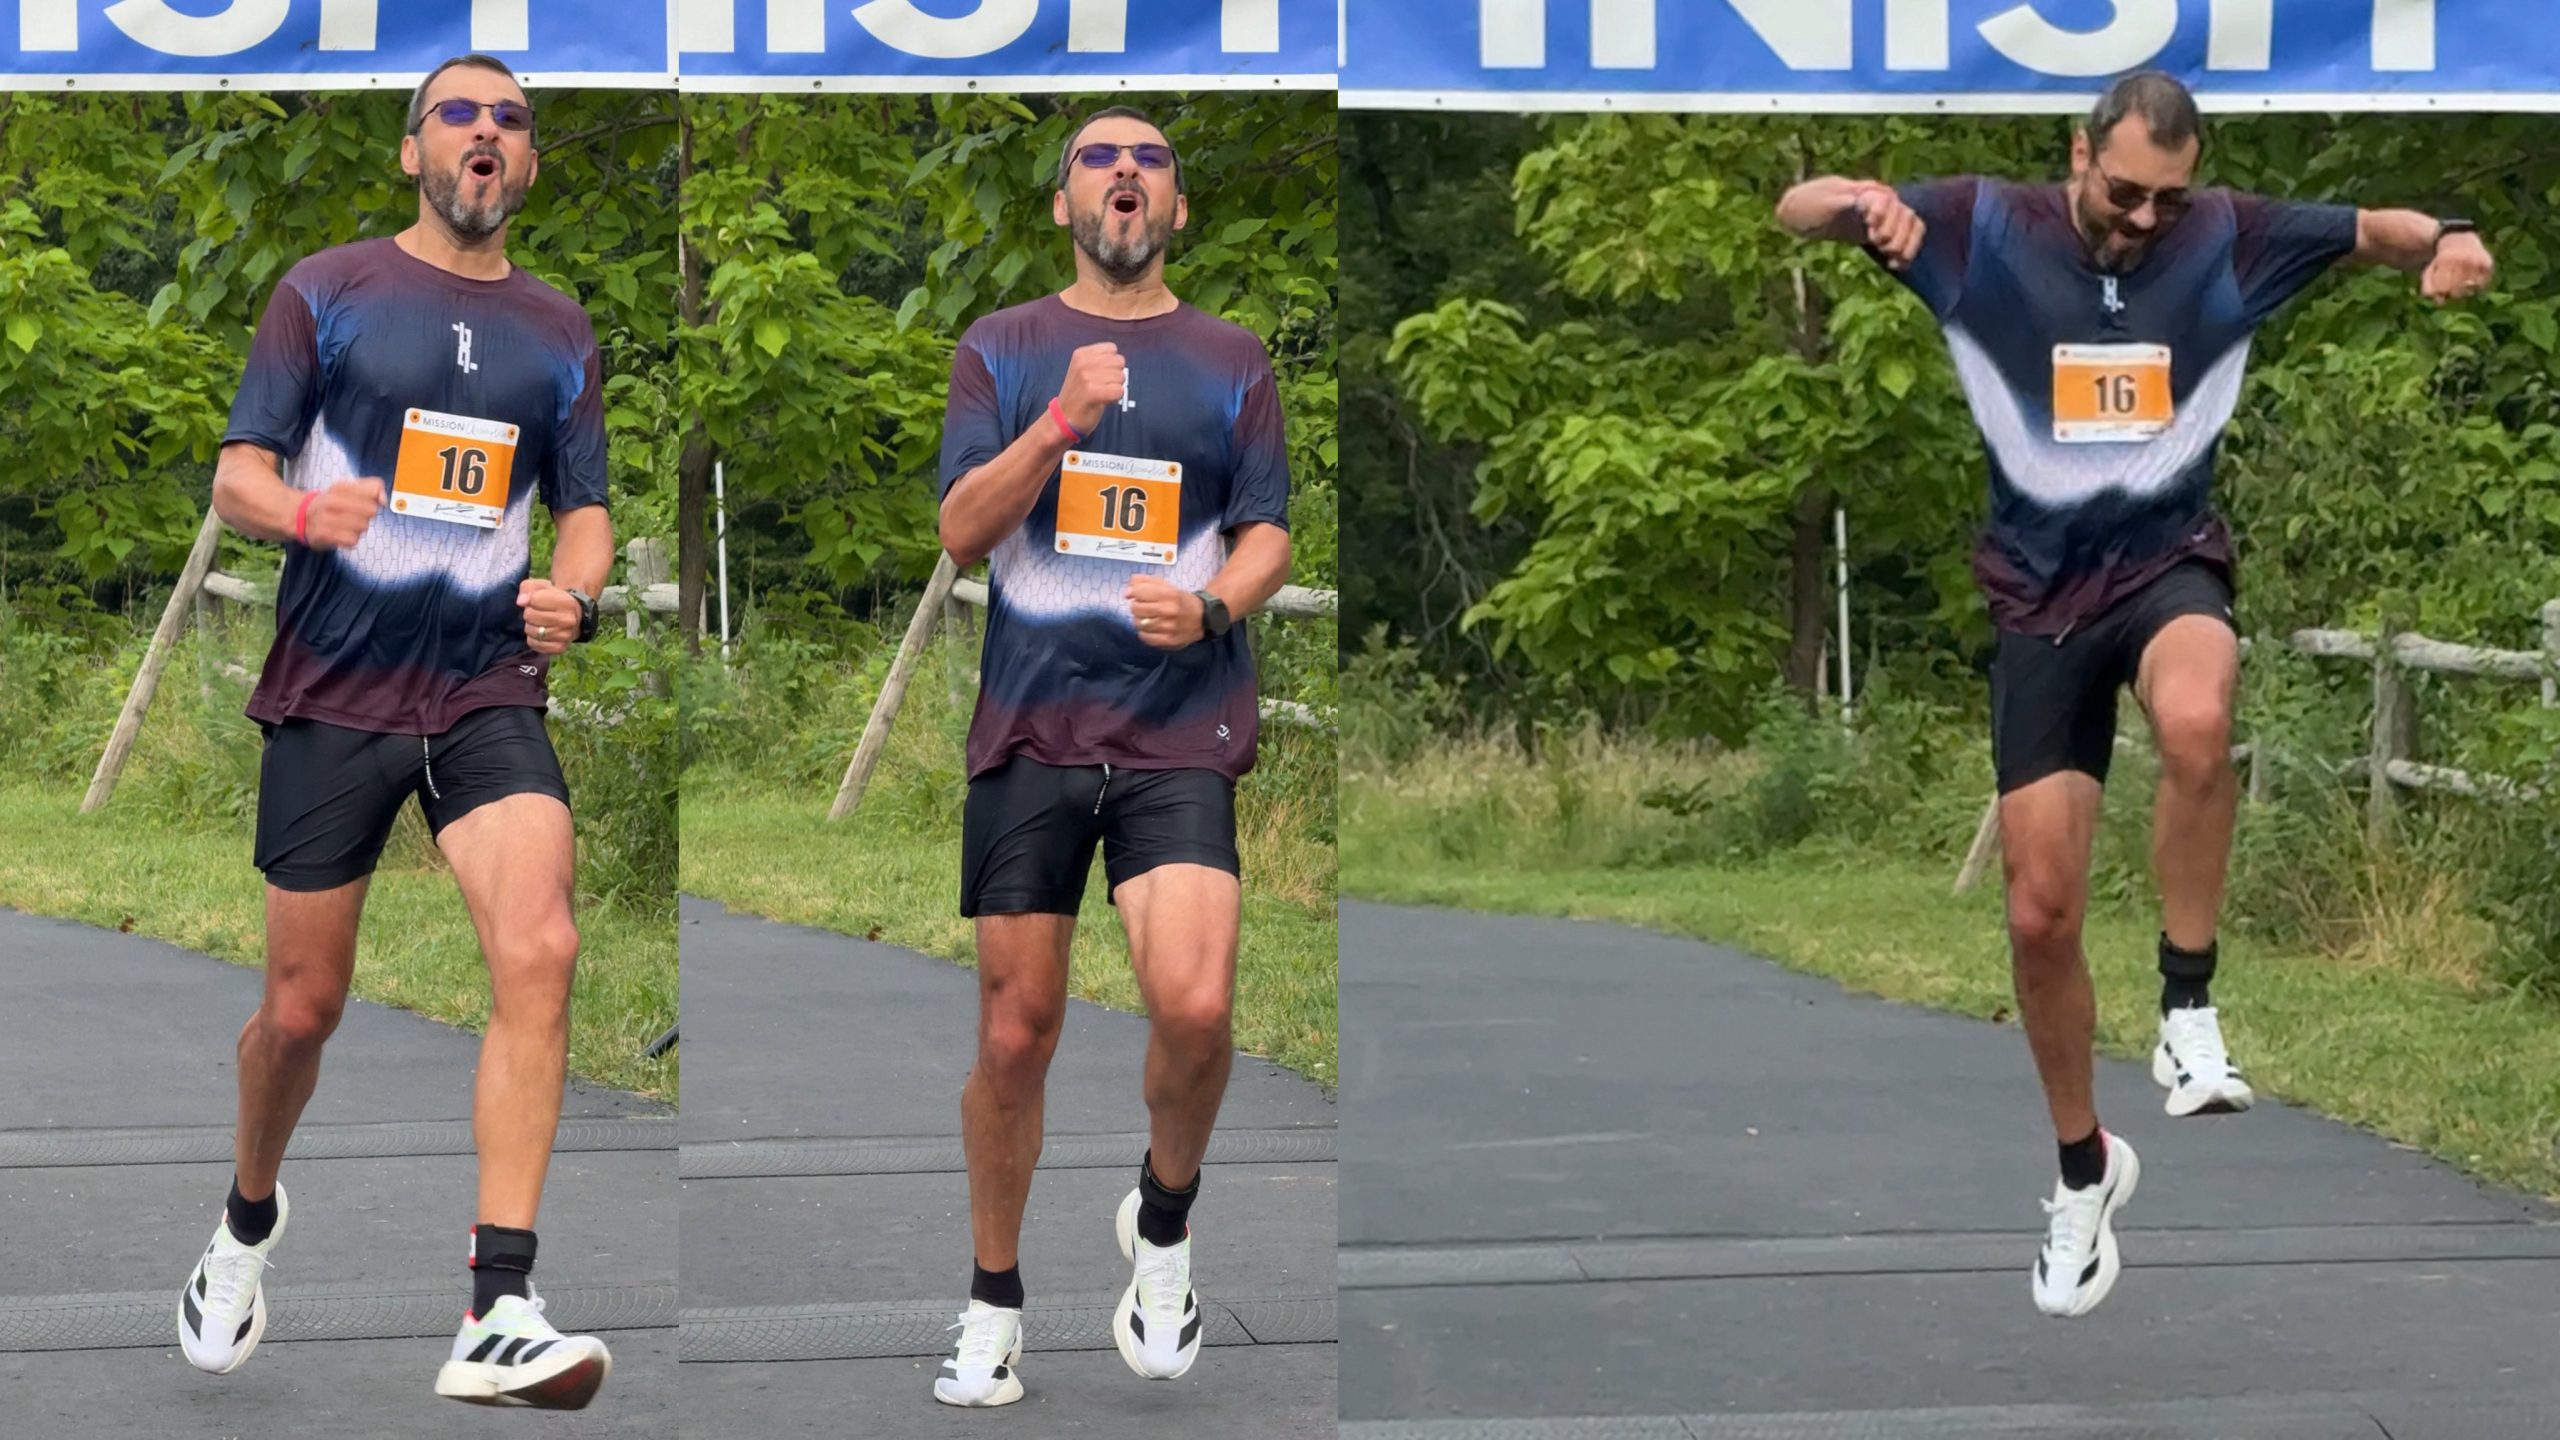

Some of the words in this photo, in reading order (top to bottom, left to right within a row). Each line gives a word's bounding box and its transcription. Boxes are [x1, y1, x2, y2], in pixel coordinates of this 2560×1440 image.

[2093, 374, 2136, 414] 16
[422, 417, 465, 431] MISSION
[439, 446, 487, 495] 16
[1082, 459, 1124, 472] MISSION
[1099, 485, 1147, 532] 16
